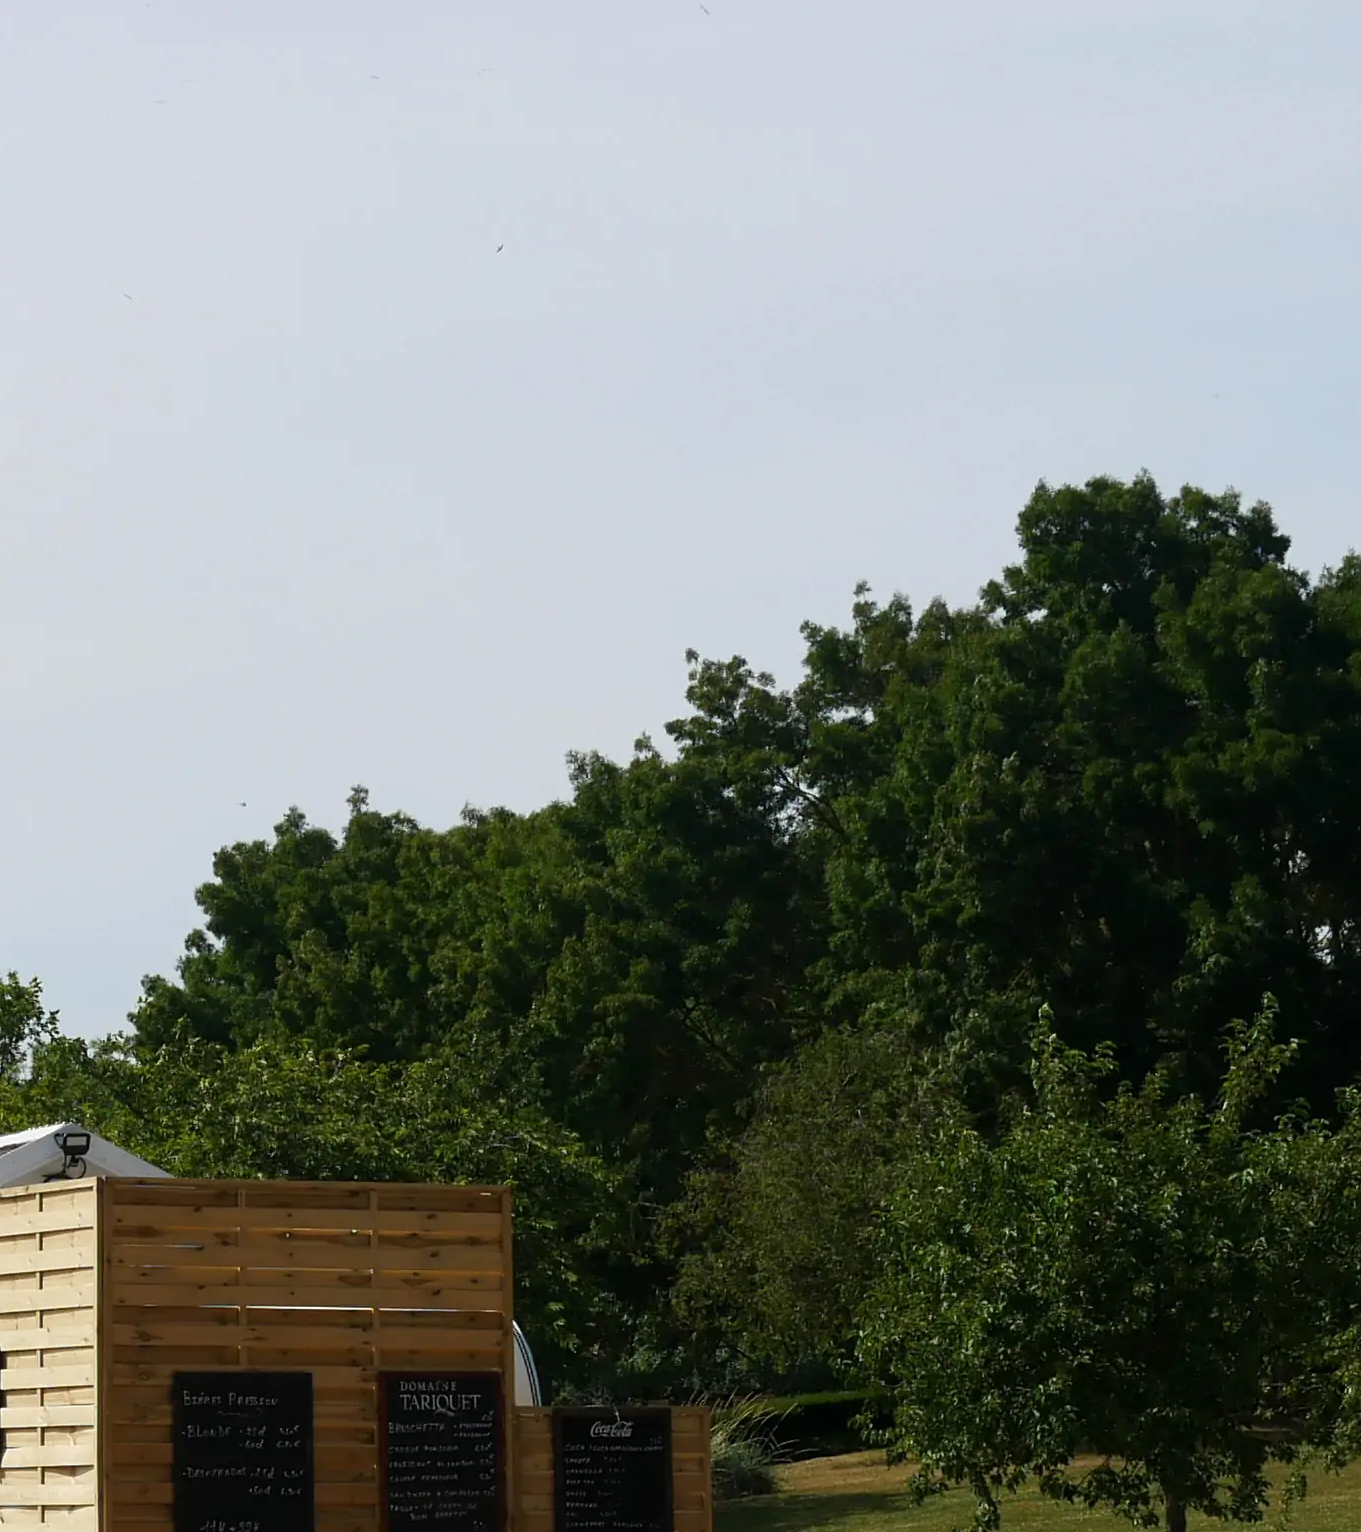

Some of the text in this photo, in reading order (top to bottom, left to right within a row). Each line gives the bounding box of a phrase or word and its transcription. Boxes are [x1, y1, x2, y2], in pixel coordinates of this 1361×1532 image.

[399, 1380, 458, 1391] DOMAINE
[228, 1391, 278, 1406] PRESSION
[399, 1393, 482, 1417] TARIQUET
